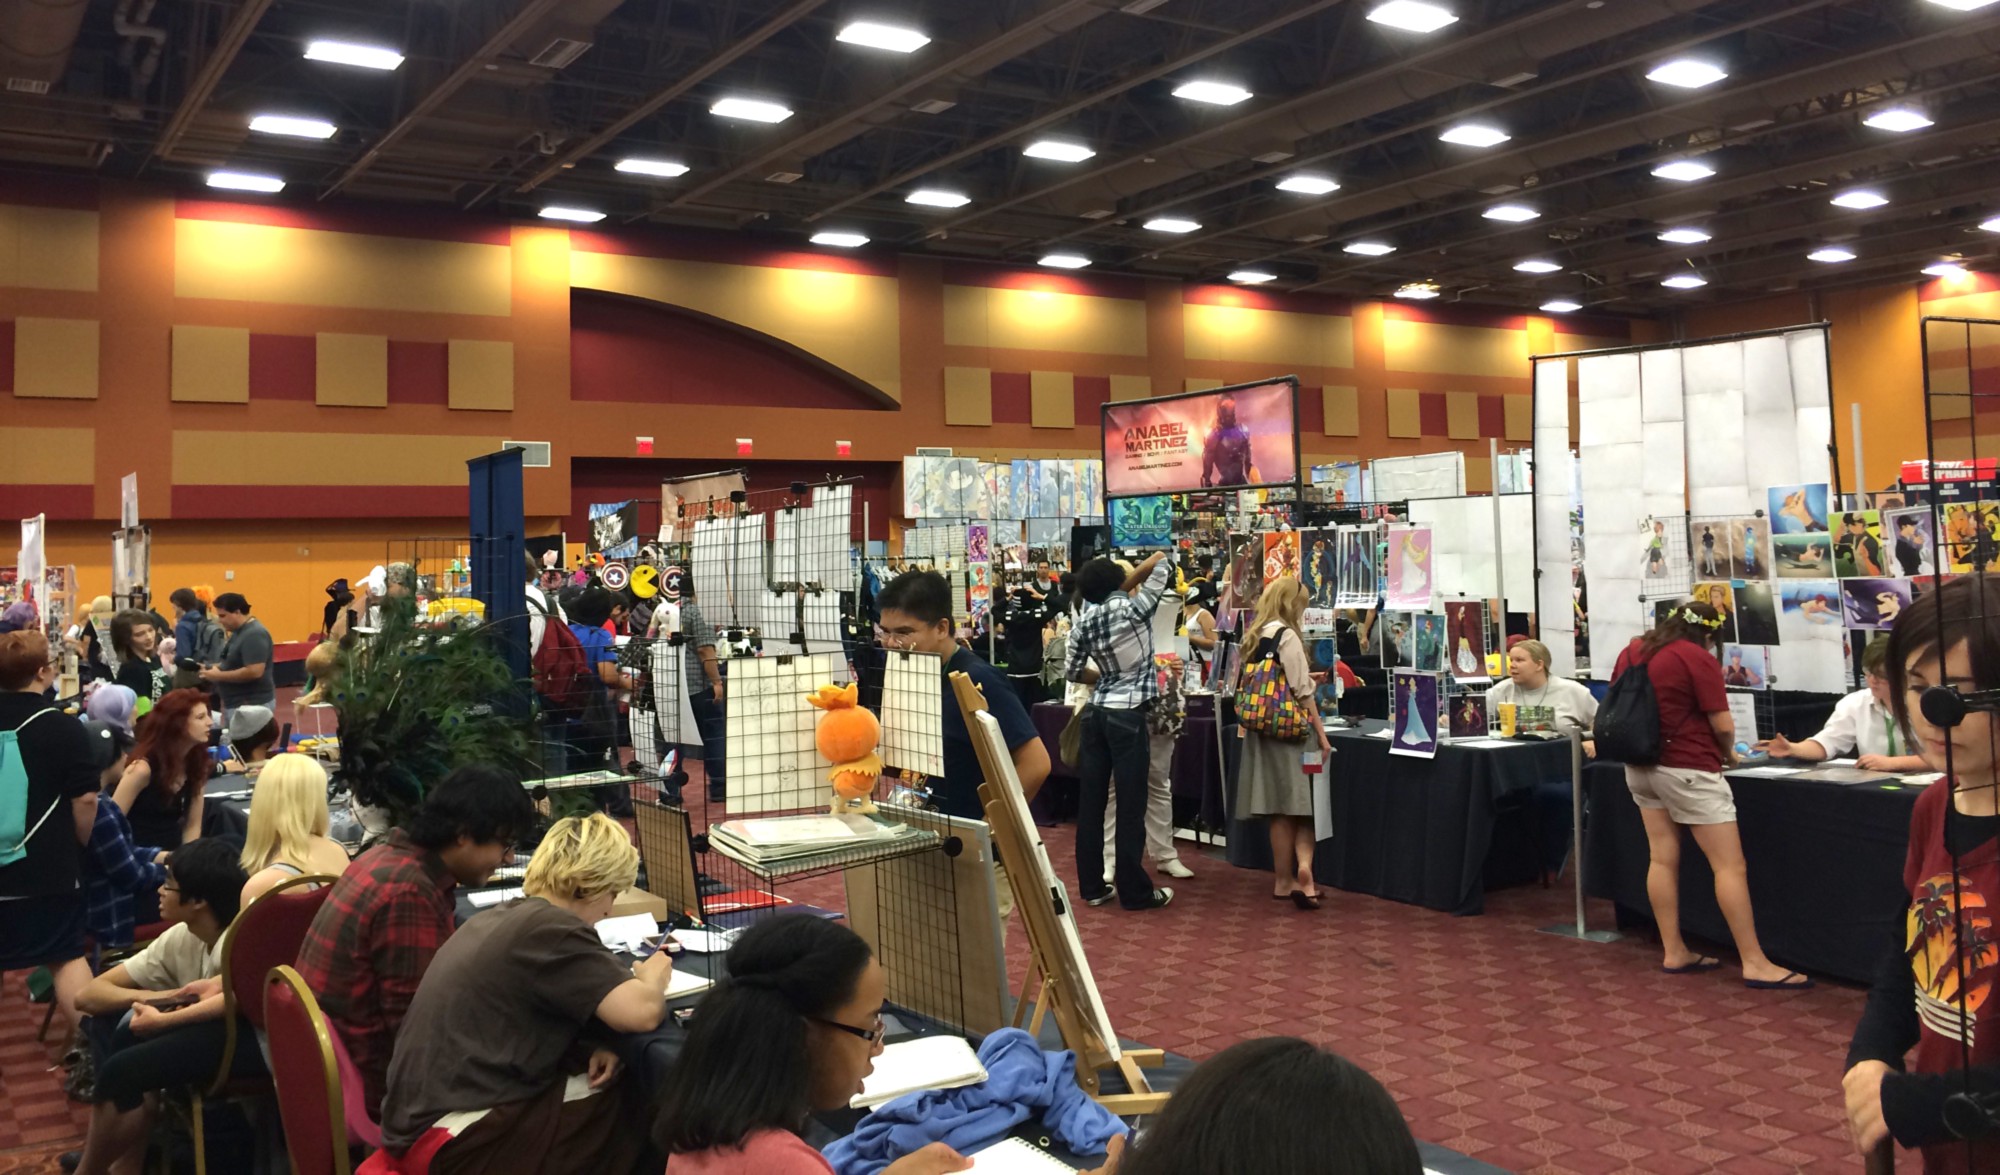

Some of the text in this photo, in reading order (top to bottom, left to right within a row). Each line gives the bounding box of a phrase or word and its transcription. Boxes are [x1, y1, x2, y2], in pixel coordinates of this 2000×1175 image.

[1124, 422, 1188, 441] ANABEL
[1125, 436, 1187, 452] MARTINEZ
[1128, 462, 1182, 471] ANABELMARTINEZ.COM
[1304, 613, 1331, 625] Hunter
